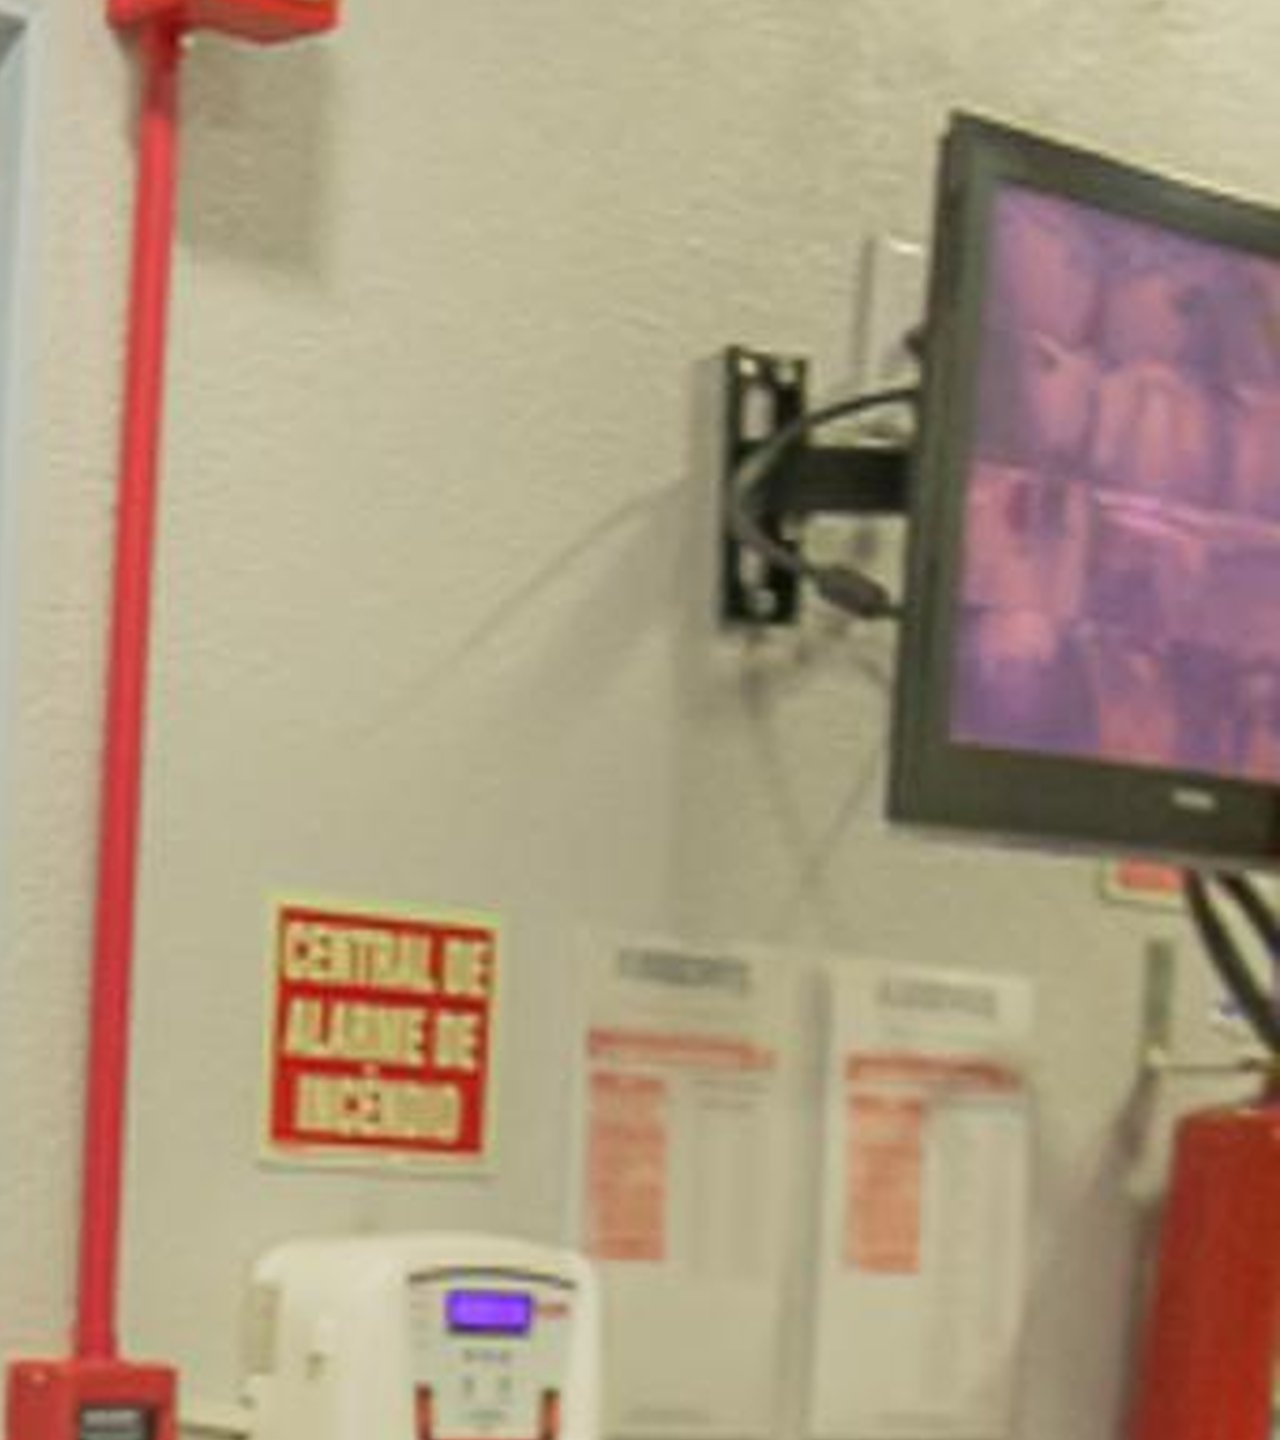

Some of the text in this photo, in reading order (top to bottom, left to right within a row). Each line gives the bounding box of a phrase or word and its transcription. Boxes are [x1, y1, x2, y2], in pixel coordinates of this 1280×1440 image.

[286, 920, 493, 1000] CENTRAL DE
[286, 996, 481, 1073] ALARME DE
